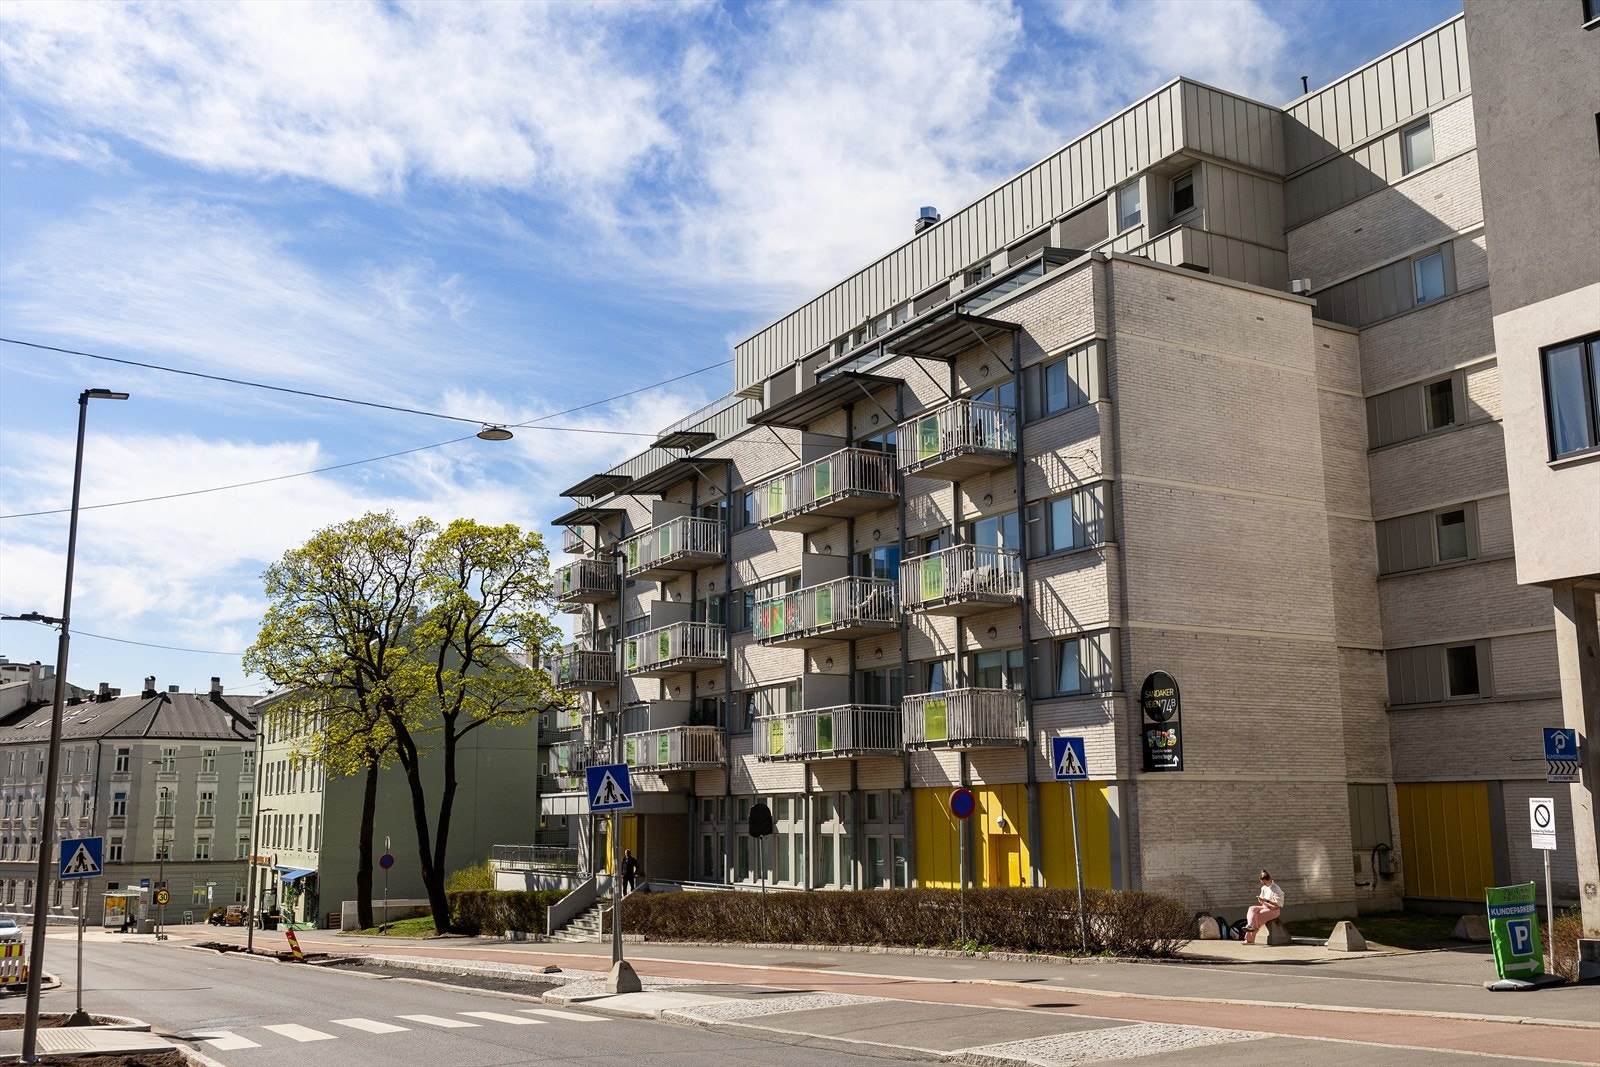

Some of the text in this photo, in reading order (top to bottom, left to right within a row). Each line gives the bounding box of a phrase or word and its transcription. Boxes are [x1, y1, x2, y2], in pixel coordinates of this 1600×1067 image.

[1145, 688, 1174, 698] SANDAKER
[1145, 700, 1161, 708] VEIEN
[1147, 728, 1177, 747] FUS
[159, 893, 168, 901] 30
[1514, 926, 1528, 950] P
